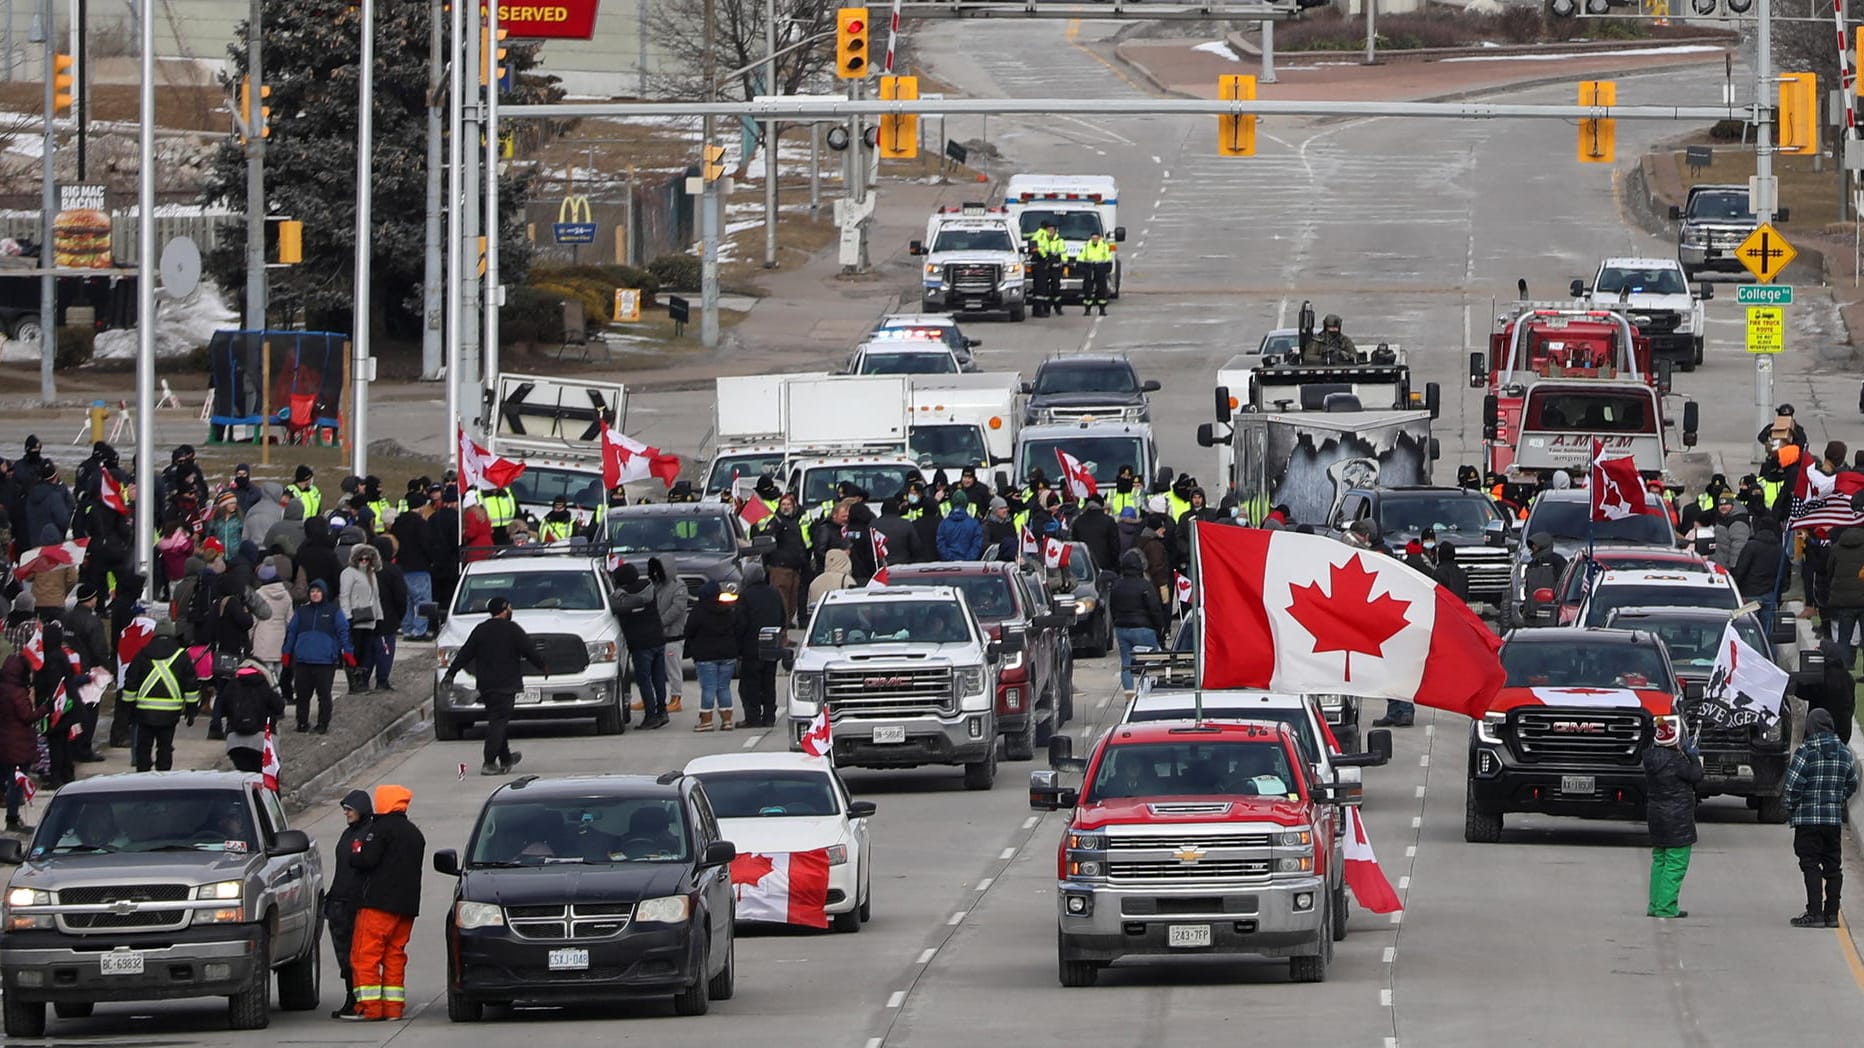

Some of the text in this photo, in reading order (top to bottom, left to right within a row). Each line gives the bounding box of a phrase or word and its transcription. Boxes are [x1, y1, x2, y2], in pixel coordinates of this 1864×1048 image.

[61, 185, 106, 197] BIG MAC
[61, 197, 105, 211] BACON!
[1738, 287, 1781, 304] College
[863, 676, 912, 688] GMC
[1553, 721, 1606, 733] GMC
